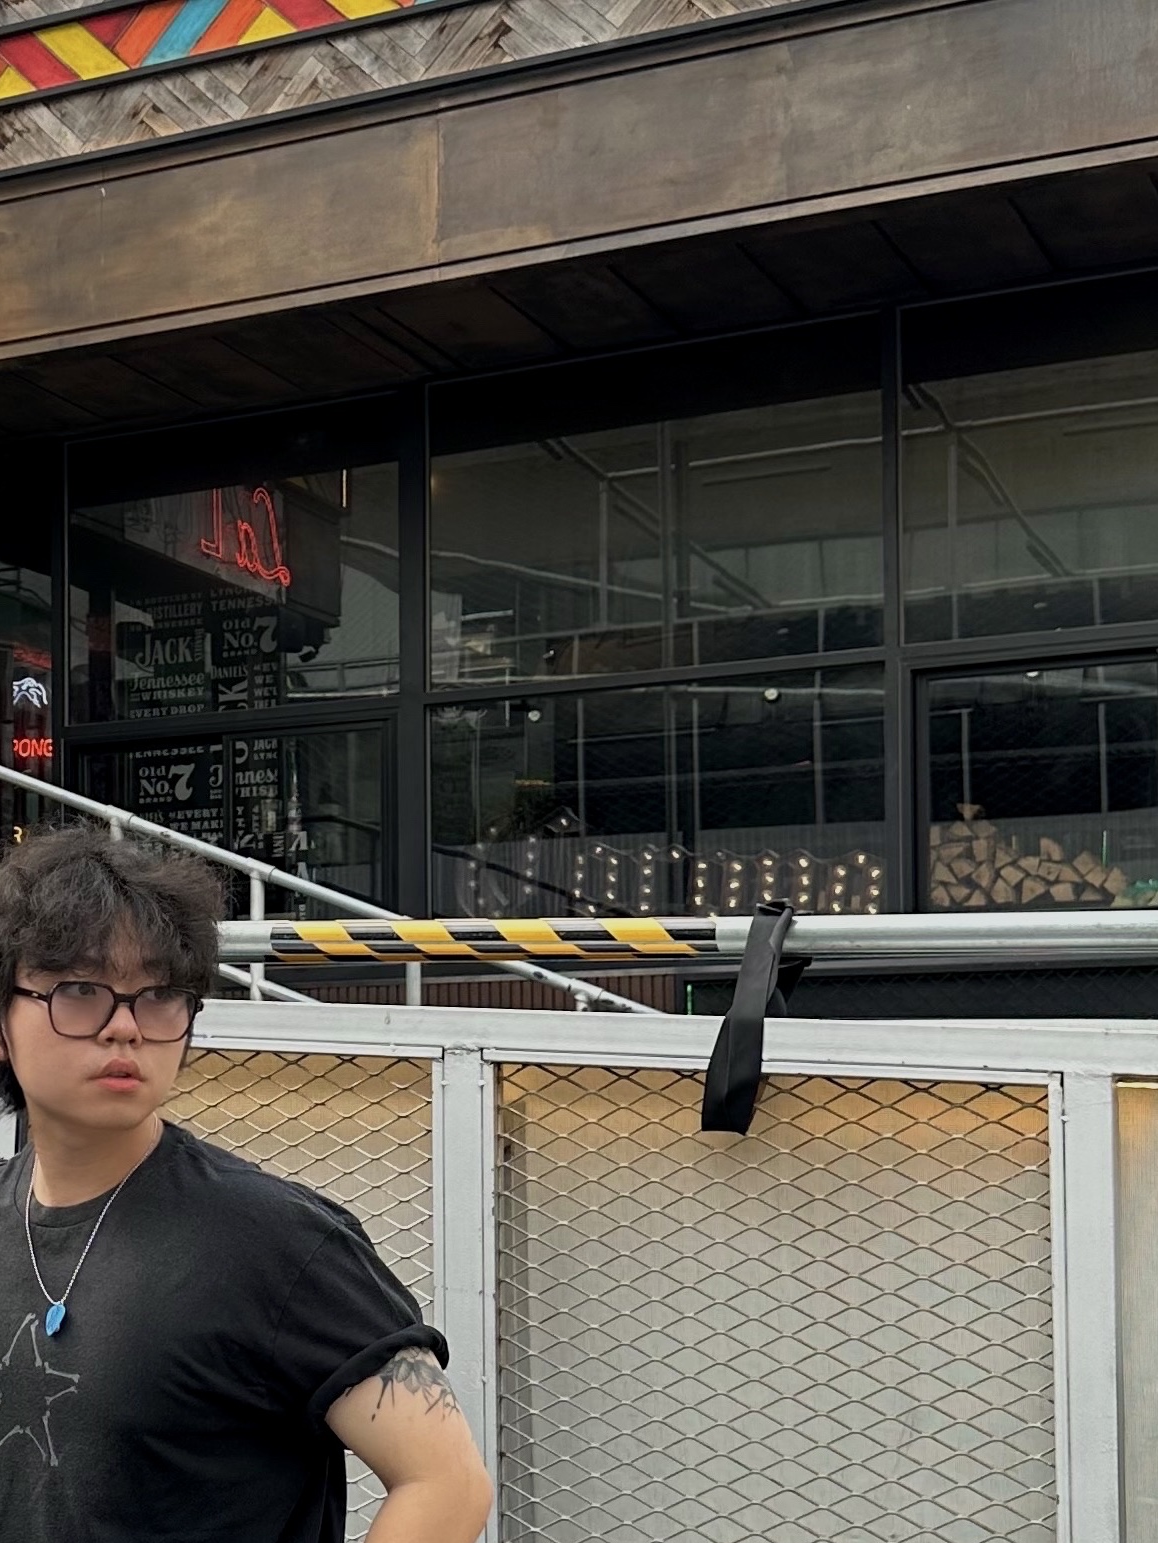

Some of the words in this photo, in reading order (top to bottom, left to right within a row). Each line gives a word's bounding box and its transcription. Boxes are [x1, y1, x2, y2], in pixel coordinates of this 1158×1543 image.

[211, 595, 277, 612] TENNESS
[253, 616, 277, 653] 7
[133, 633, 193, 670] JACK
[129, 671, 204, 692] Tennessee
[139, 765, 166, 778] Old
[139, 778, 174, 797] No.
[168, 763, 196, 801] 7
